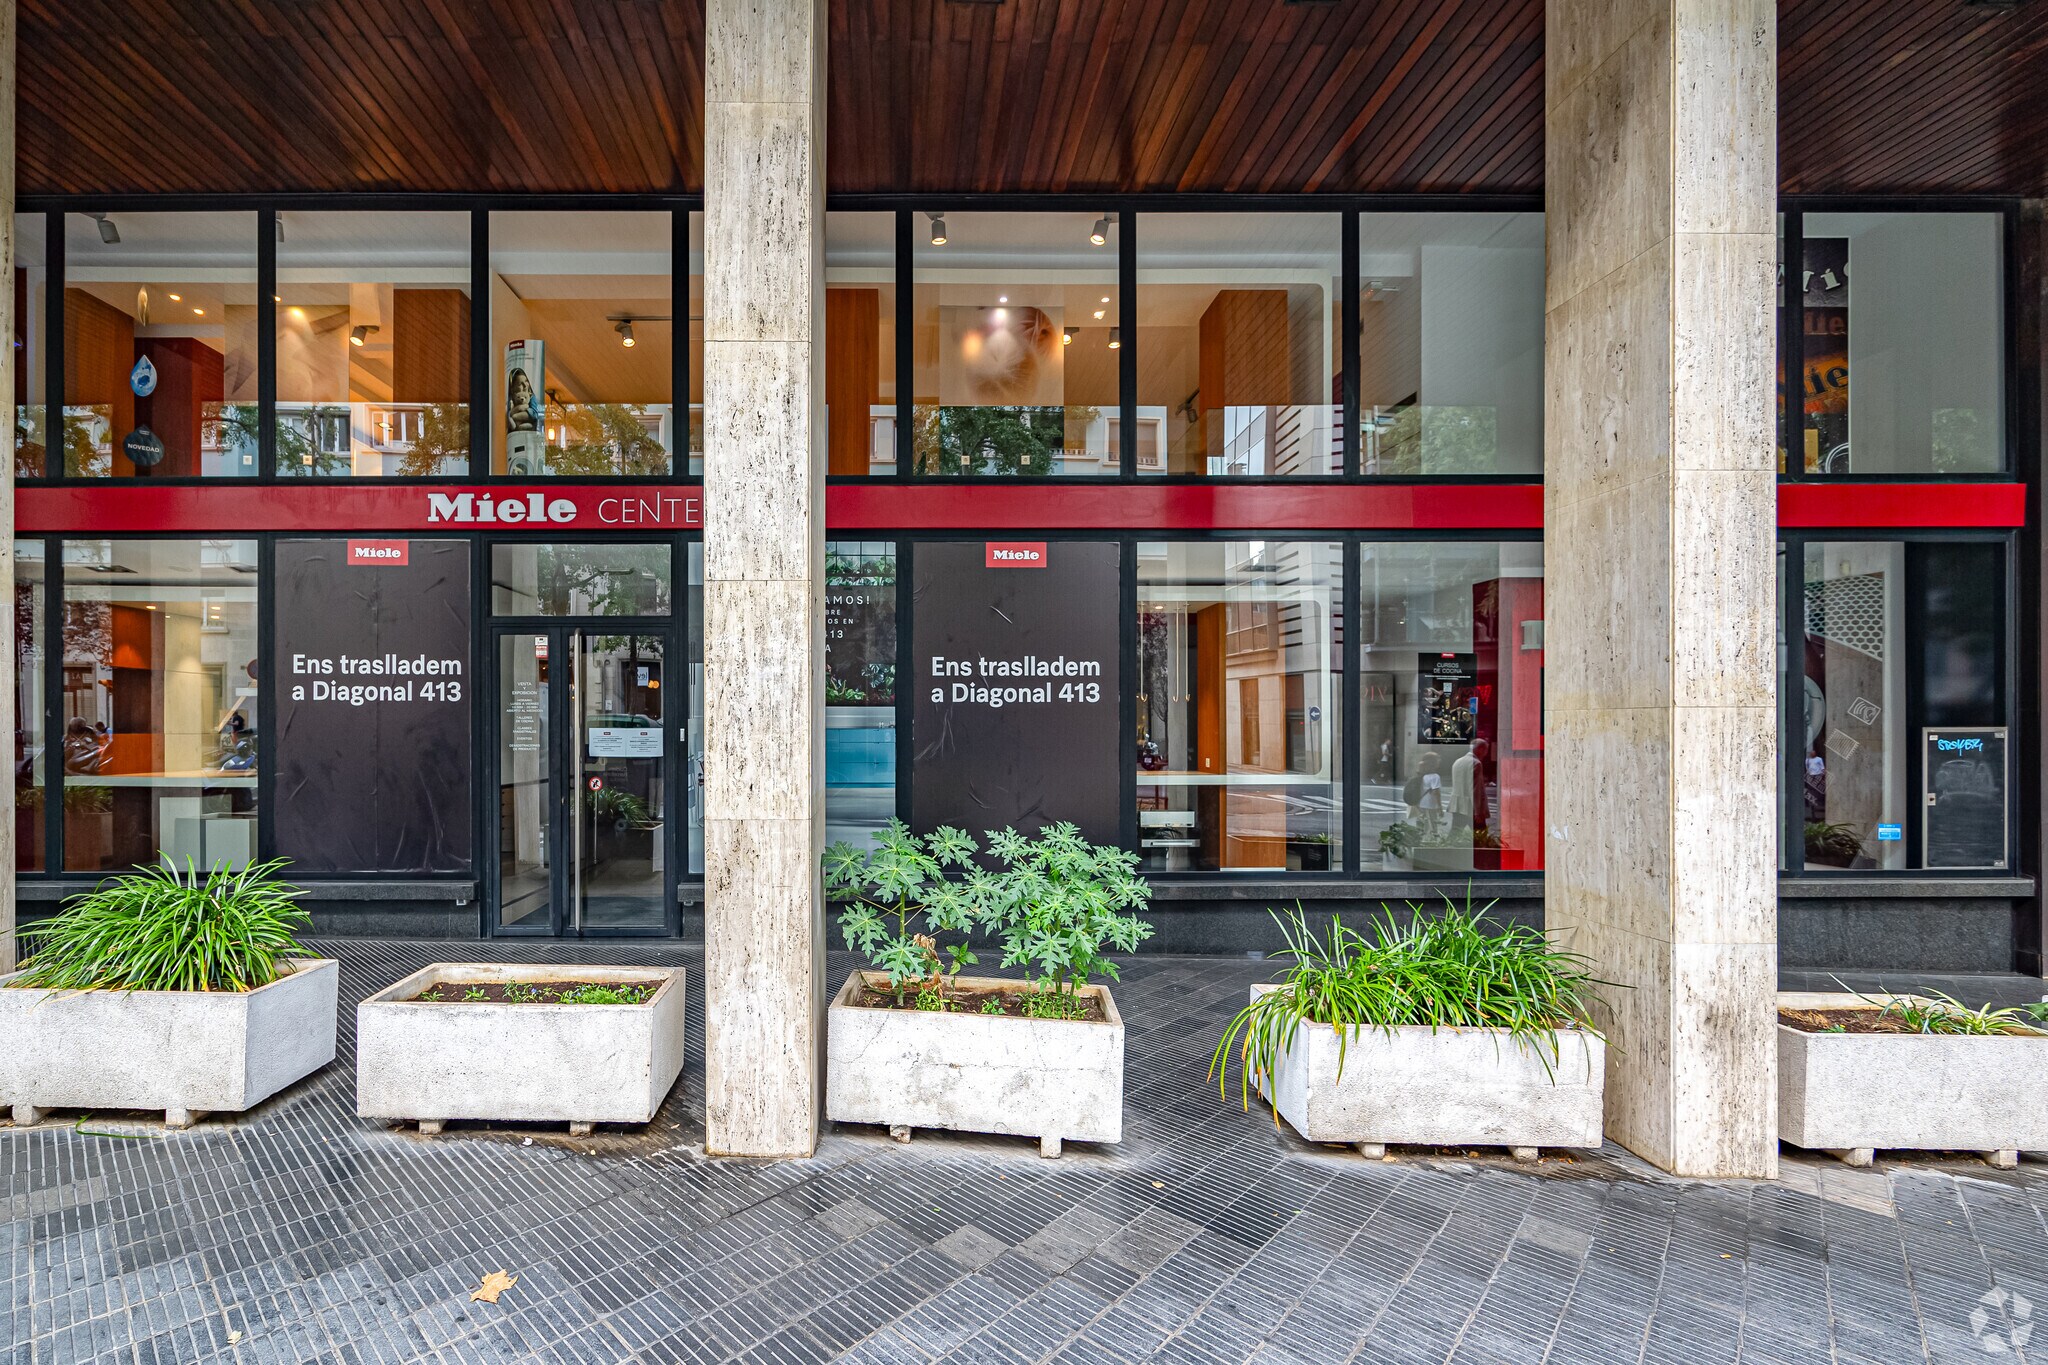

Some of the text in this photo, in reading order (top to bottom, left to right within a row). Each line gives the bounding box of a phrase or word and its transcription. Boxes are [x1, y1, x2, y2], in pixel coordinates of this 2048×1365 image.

[127, 443, 160, 453] NOVEDAD
[427, 492, 578, 523] Miele
[354, 547, 402, 558] Miele
[993, 549, 1040, 560] Miele
[292, 653, 462, 675] Ens traslladem
[931, 655, 1101, 677] Ens traslladem
[292, 680, 462, 706] a Diagonal 413
[931, 682, 1101, 708] a Diagonal 413
